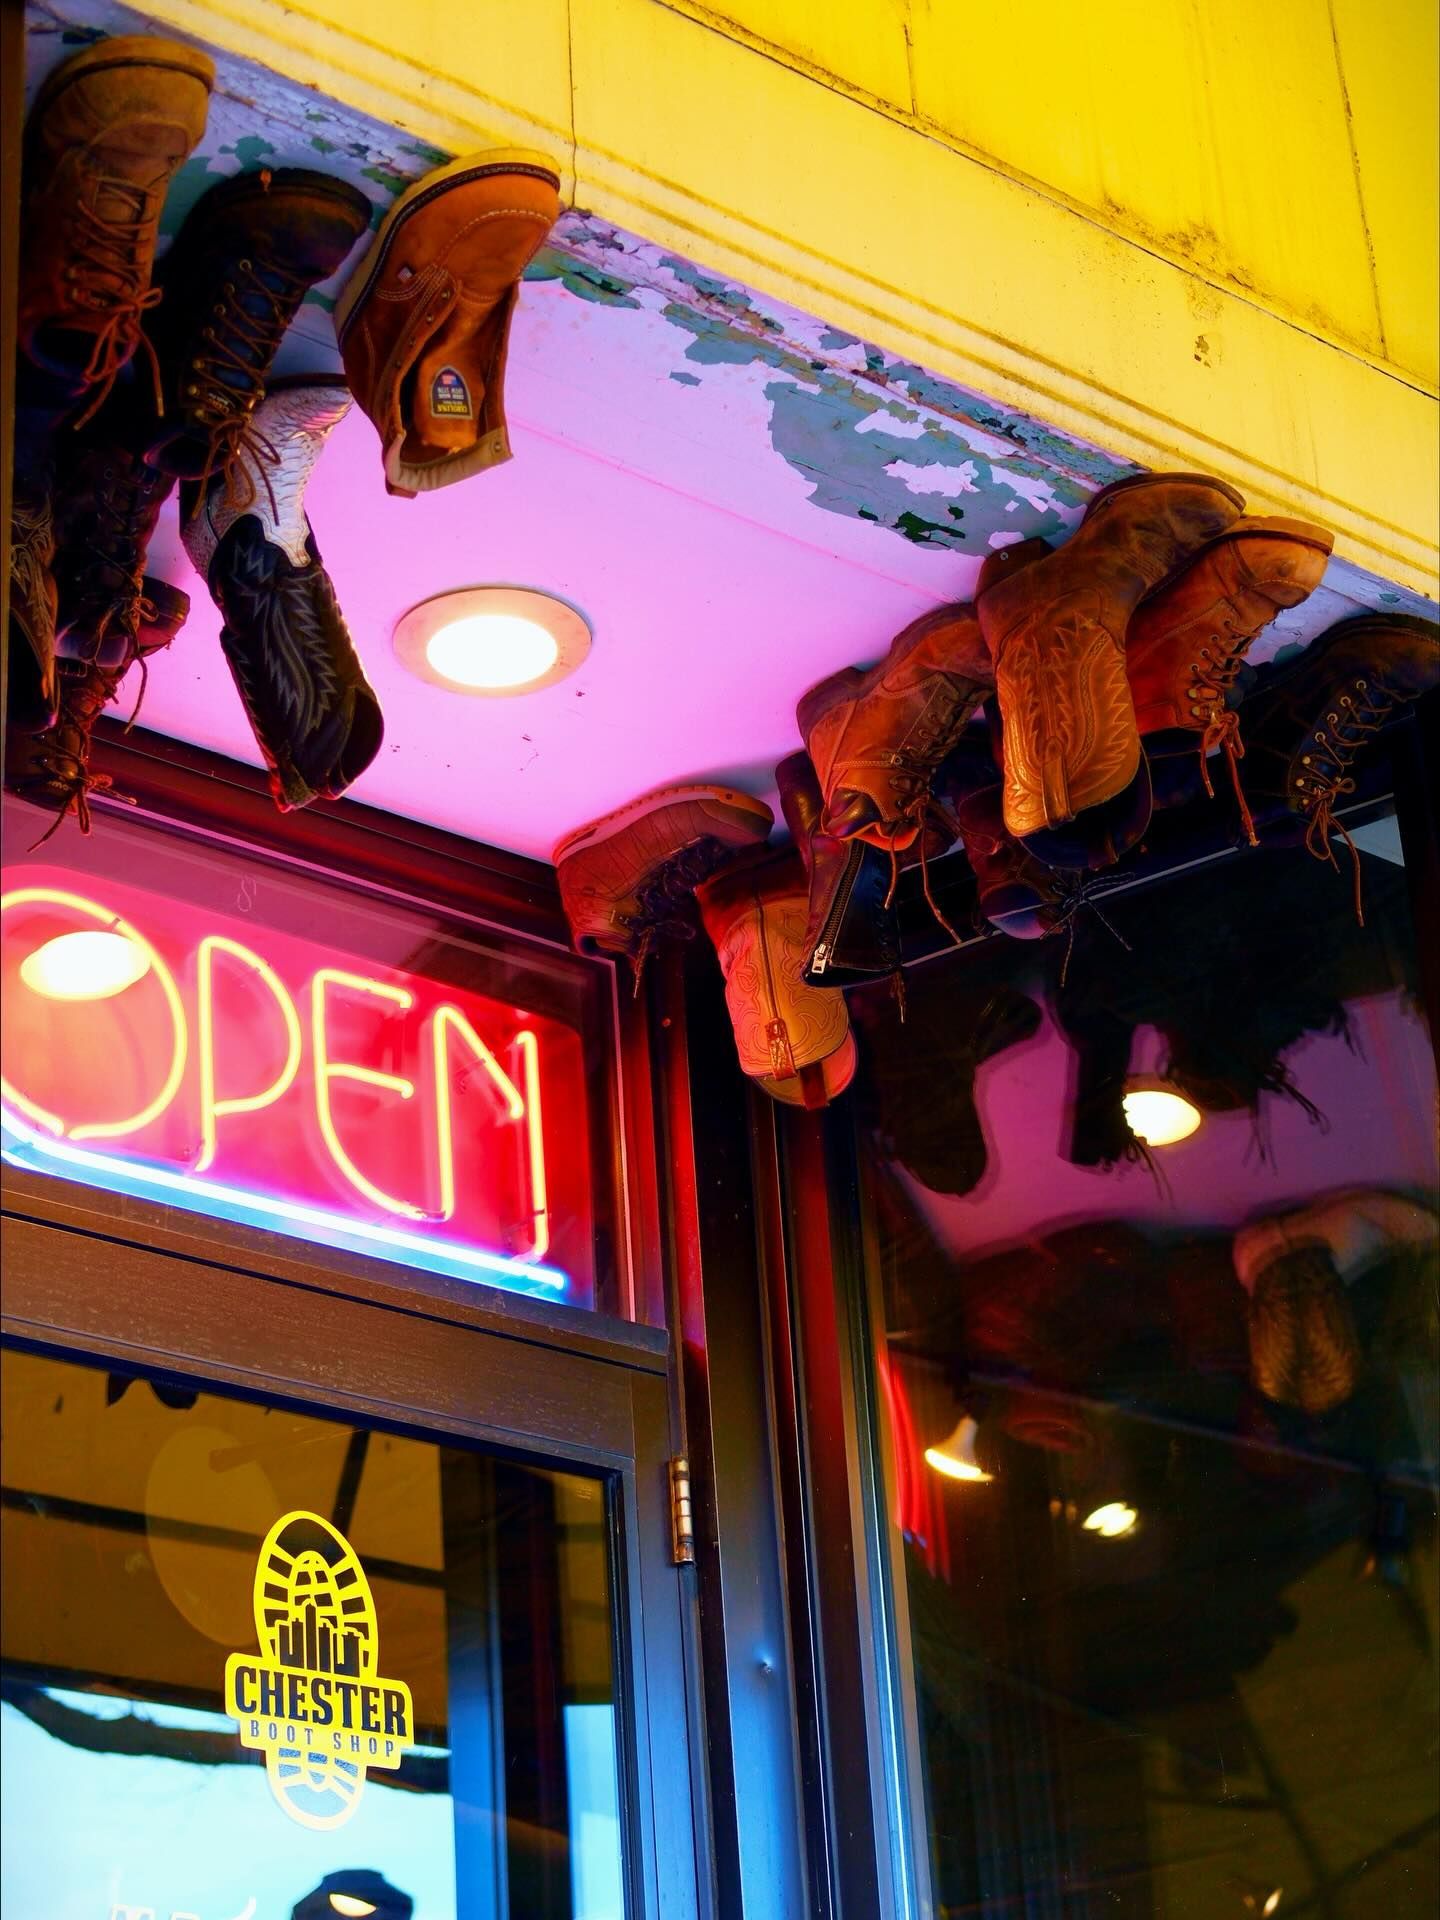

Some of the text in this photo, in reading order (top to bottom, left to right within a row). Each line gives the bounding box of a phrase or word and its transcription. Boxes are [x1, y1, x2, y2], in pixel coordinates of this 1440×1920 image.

[0, 887, 549, 1263] OPEN
[234, 1665, 407, 1737] CHESTER
[249, 1719, 395, 1758] BOOT SHOP
